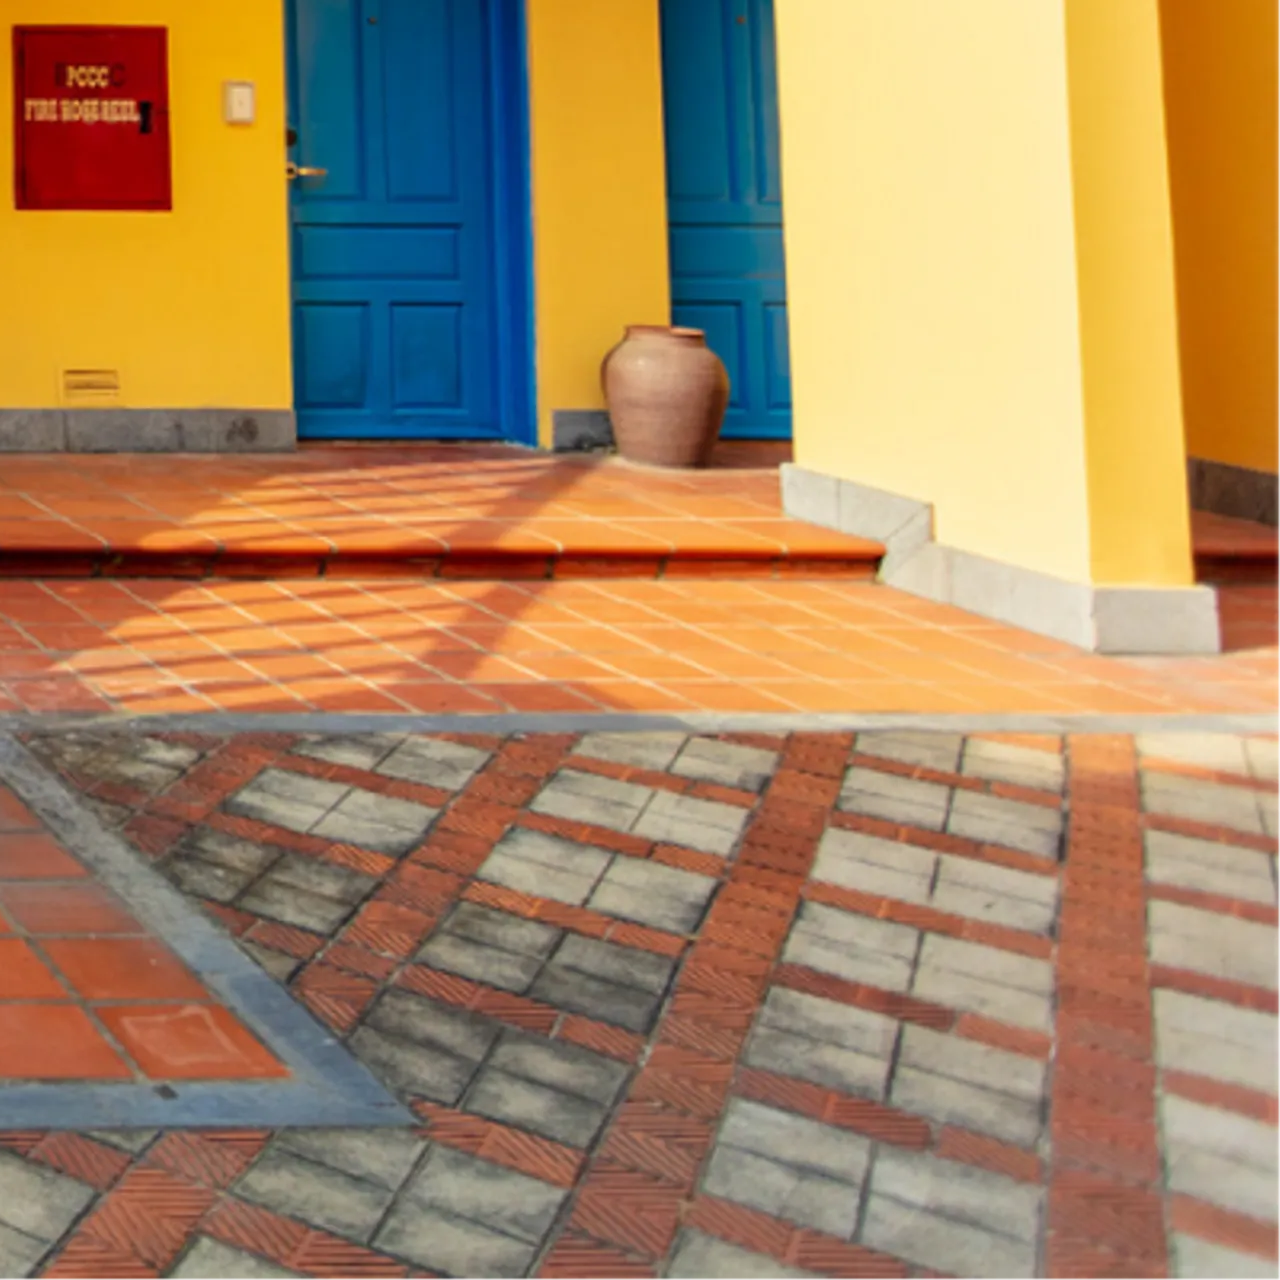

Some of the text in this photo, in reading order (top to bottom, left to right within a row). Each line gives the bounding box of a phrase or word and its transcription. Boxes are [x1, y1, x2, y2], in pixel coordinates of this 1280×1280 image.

[66, 65, 109, 87] PCCC
[24, 99, 139, 122] FIRE HOSE REEL
